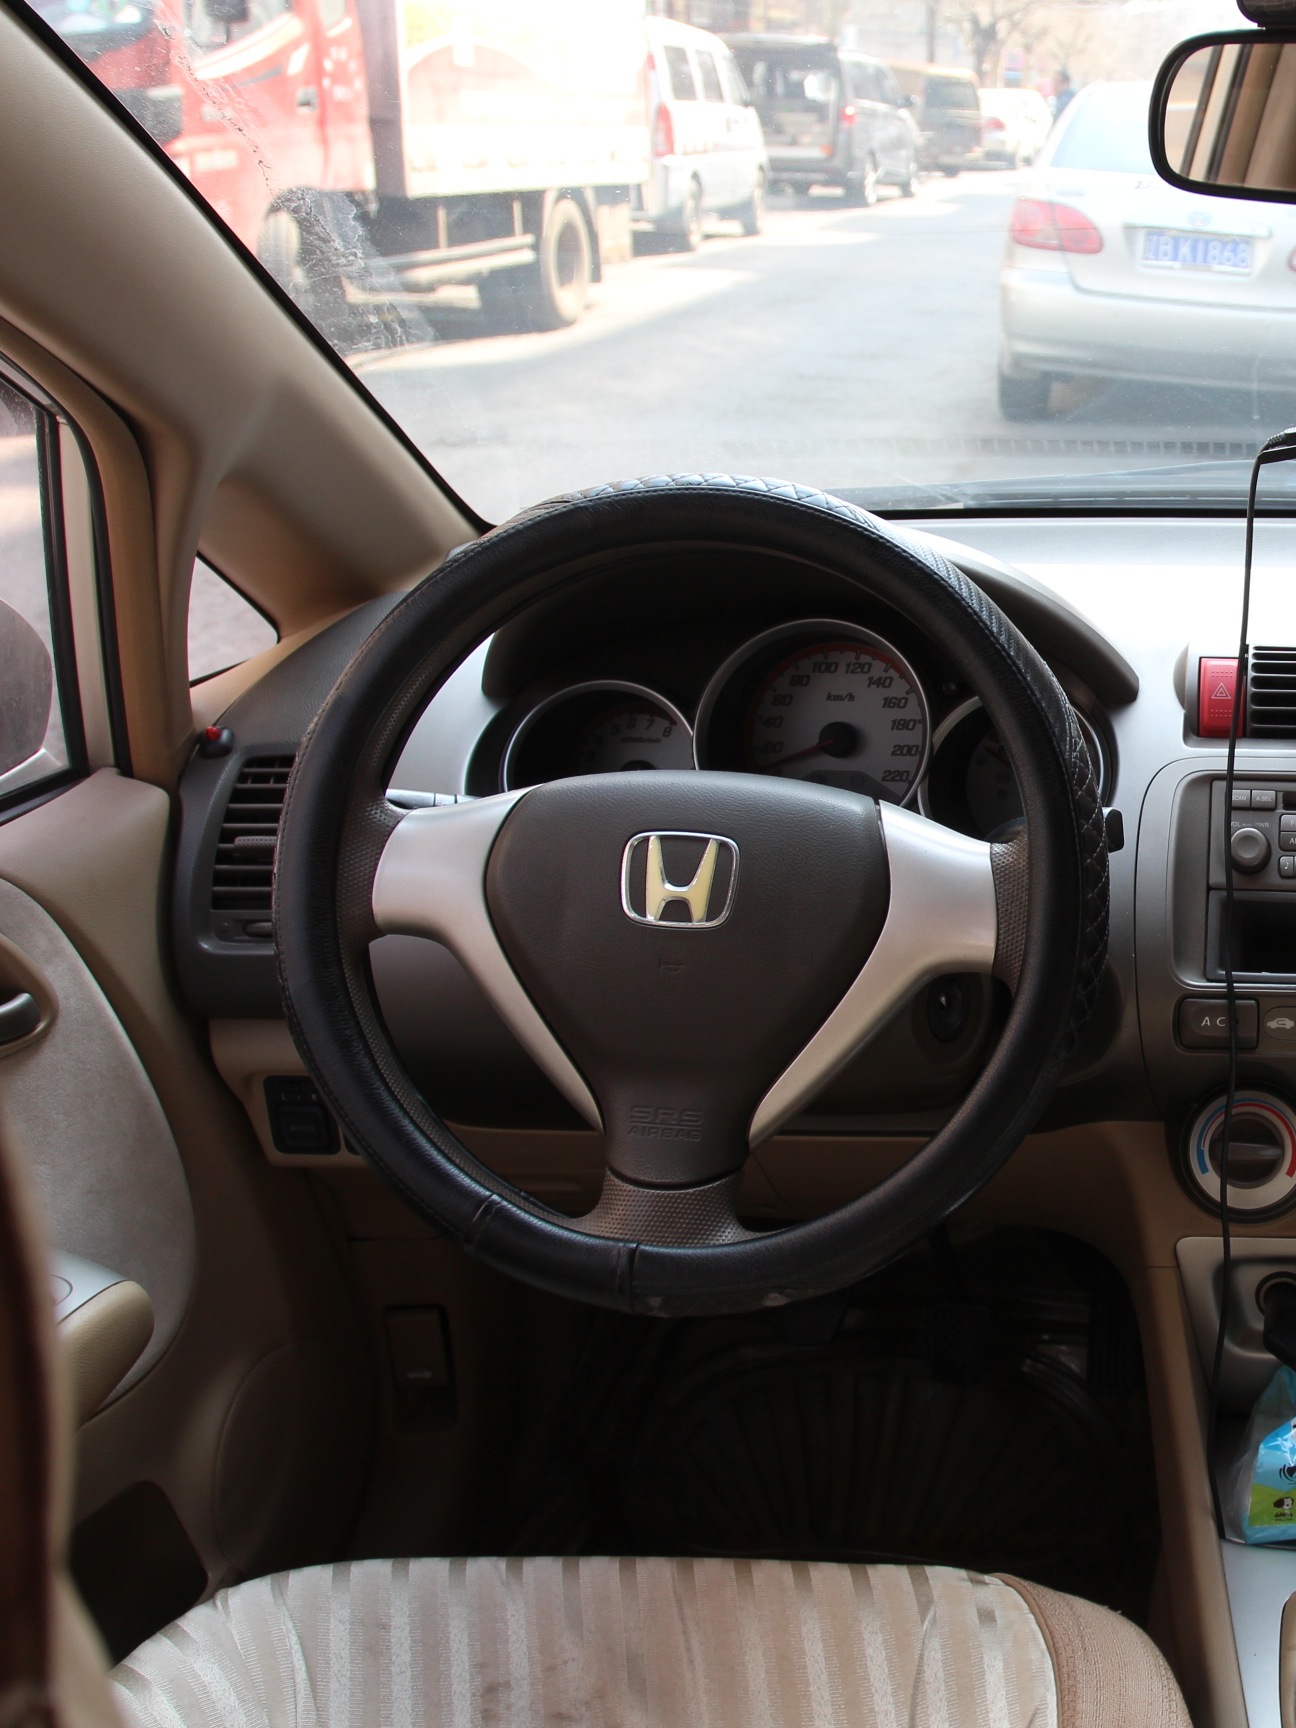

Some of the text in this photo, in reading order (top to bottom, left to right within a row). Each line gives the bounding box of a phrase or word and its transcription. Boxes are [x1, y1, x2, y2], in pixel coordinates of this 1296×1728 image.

[811, 661, 839, 675] 100
[844, 661, 872, 675] 120
[789, 674, 811, 687] 80
[866, 676, 893, 689] 140
[772, 694, 794, 707] 60
[825, 692, 856, 703] km/h
[882, 697, 908, 710] 160
[626, 717, 637, 729] 6
[645, 718, 656, 730] 7
[763, 715, 784, 729] 40
[890, 718, 917, 732] 180
[662, 726, 673, 738] 8
[890, 743, 918, 757] 200
[880, 770, 911, 783] 220
[630, 1105, 703, 1125] SRS
[628, 1125, 702, 1141] AIRBAG
